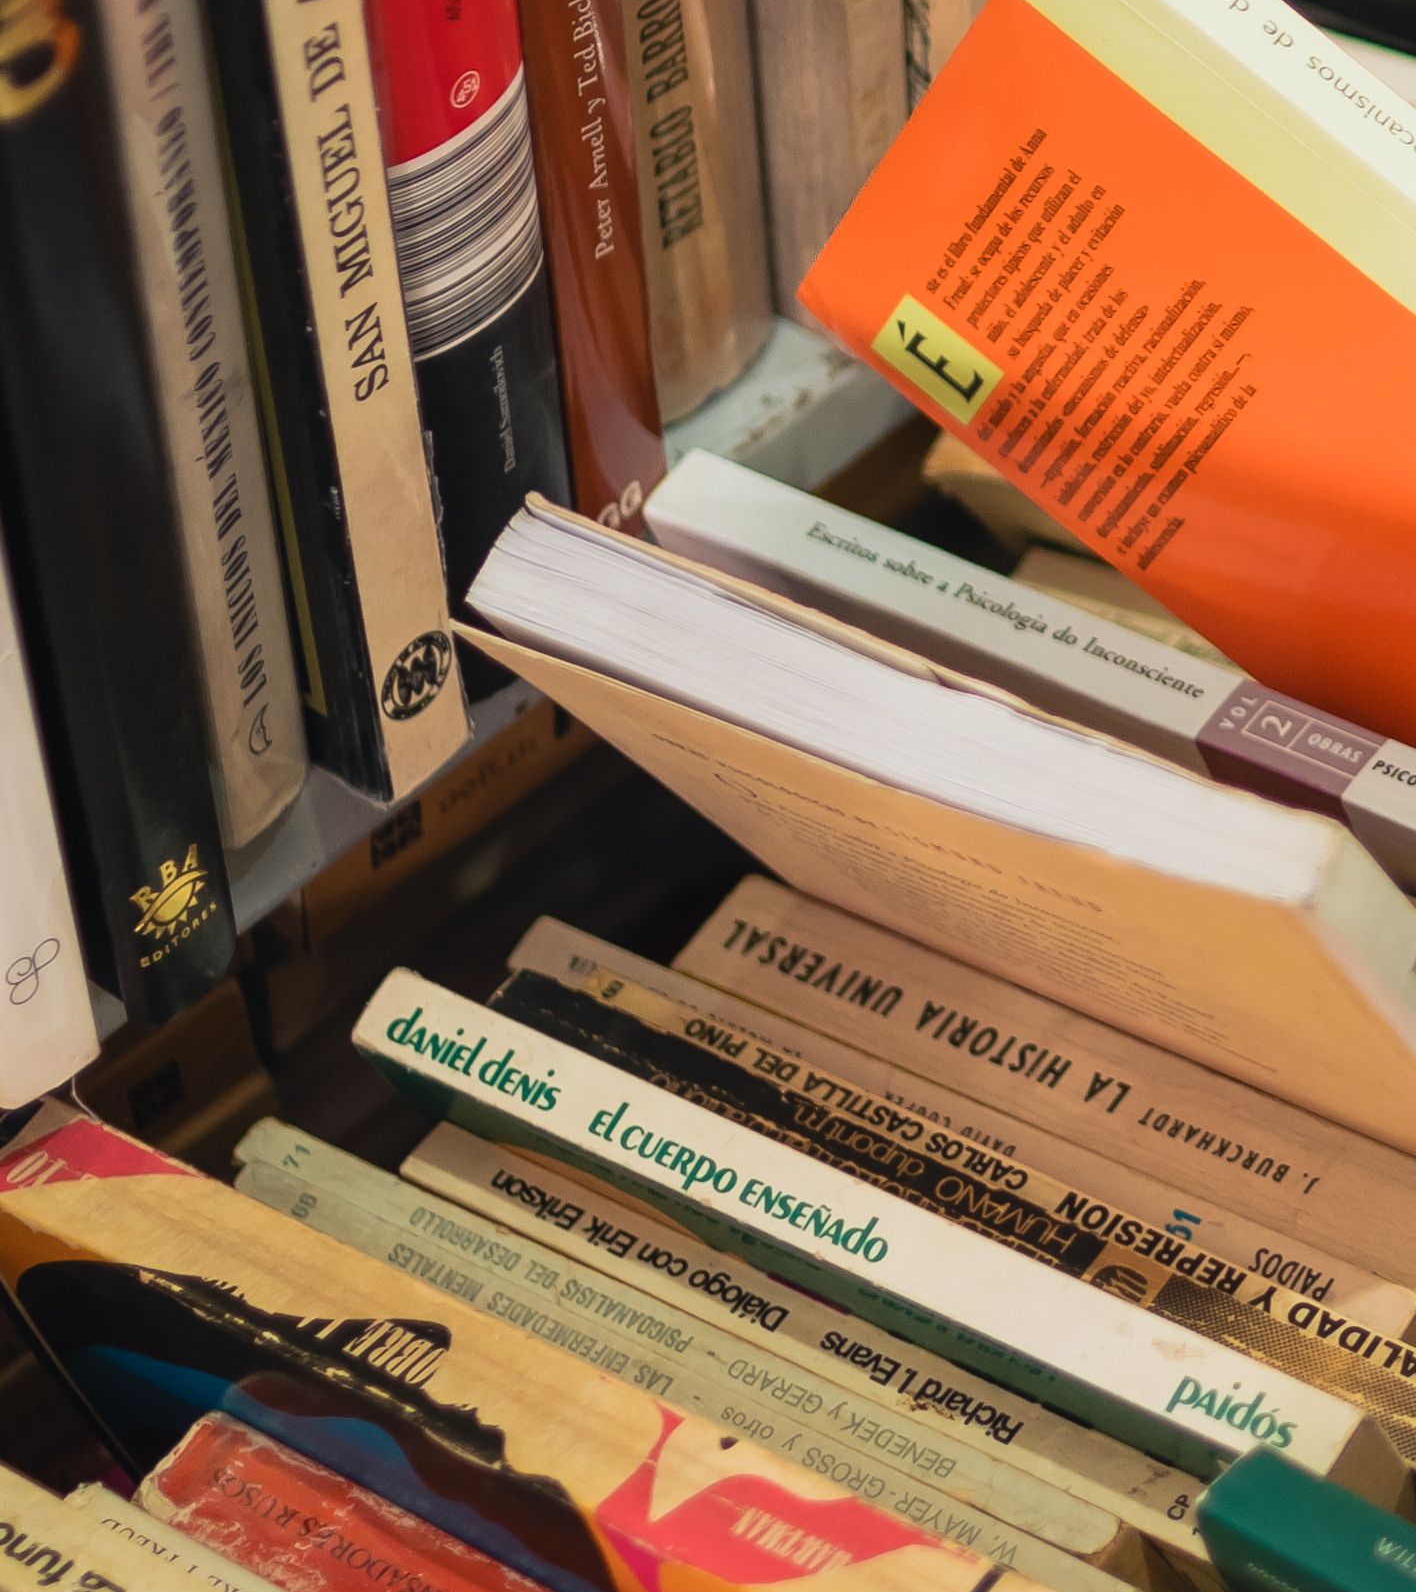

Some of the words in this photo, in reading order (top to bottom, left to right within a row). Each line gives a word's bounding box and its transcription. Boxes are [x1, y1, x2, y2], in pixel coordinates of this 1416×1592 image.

[300, 19, 349, 101] DE
[1255, 15, 1296, 54] de
[573, 42, 602, 93] Ted
[585, 95, 608, 114] y
[581, 119, 610, 189] Arnell
[647, 106, 707, 249] RETABLO
[314, 103, 378, 298] MIGUEL
[589, 196, 617, 258] Peter
[342, 301, 393, 401] SAN
[498, 430, 516, 474] Daniel
[207, 470, 248, 539] DEL
[216, 534, 266, 651] INICIOS
[804, 514, 884, 566] Escritos
[881, 547, 937, 587] sobre
[934, 578, 948, 593] a
[950, 578, 1051, 641] Psicologia
[1050, 620, 1080, 646] do
[1080, 631, 1208, 702] Inconsciente
[235, 648, 273, 705] LOS
[1218, 687, 1252, 734] VOL
[1261, 711, 1294, 744] 2
[1305, 729, 1362, 767] OBRAS
[130, 842, 203, 911] RBA
[720, 915, 903, 1020] UNIVERSAL
[679, 1012, 748, 1063] PINO
[745, 1042, 800, 1085] DEL
[912, 996, 1072, 1092] HISTORIA
[797, 1068, 927, 1146] CASTILLA
[1081, 1068, 1132, 1116] LA
[922, 1126, 1031, 1193] CARLOS
[1135, 1101, 1289, 1185] BURCKHARDT
[485, 1165, 584, 1234] Erikson
[1294, 1168, 1320, 1197] J.
[406, 1203, 522, 1274] DESARROLLO
[579, 1212, 639, 1261] Erik
[636, 1238, 690, 1281] con
[1052, 1186, 1249, 1297] REPRESION
[385, 1238, 483, 1302] MENTALES
[520, 1257, 558, 1292] DEL
[684, 1259, 792, 1336] Diálogo
[1246, 1243, 1335, 1303] PAIDOS
[1247, 1277, 1282, 1314] Y
[484, 1287, 631, 1375] ENFERMEDADES
[557, 1274, 694, 1356] PSICOANALISIS
[632, 1361, 675, 1397] LAS
[725, 1354, 825, 1418] GERARD
[816, 1325, 901, 1386] Evans
[717, 1402, 777, 1444] otros
[780, 1426, 802, 1452] y
[828, 1397, 849, 1422] y
[912, 1372, 1024, 1449] Richard
[840, 1408, 957, 1481] BENEDEK
[800, 1441, 984, 1548] MAYER-GROSS
[984, 1530, 1022, 1566] W.
